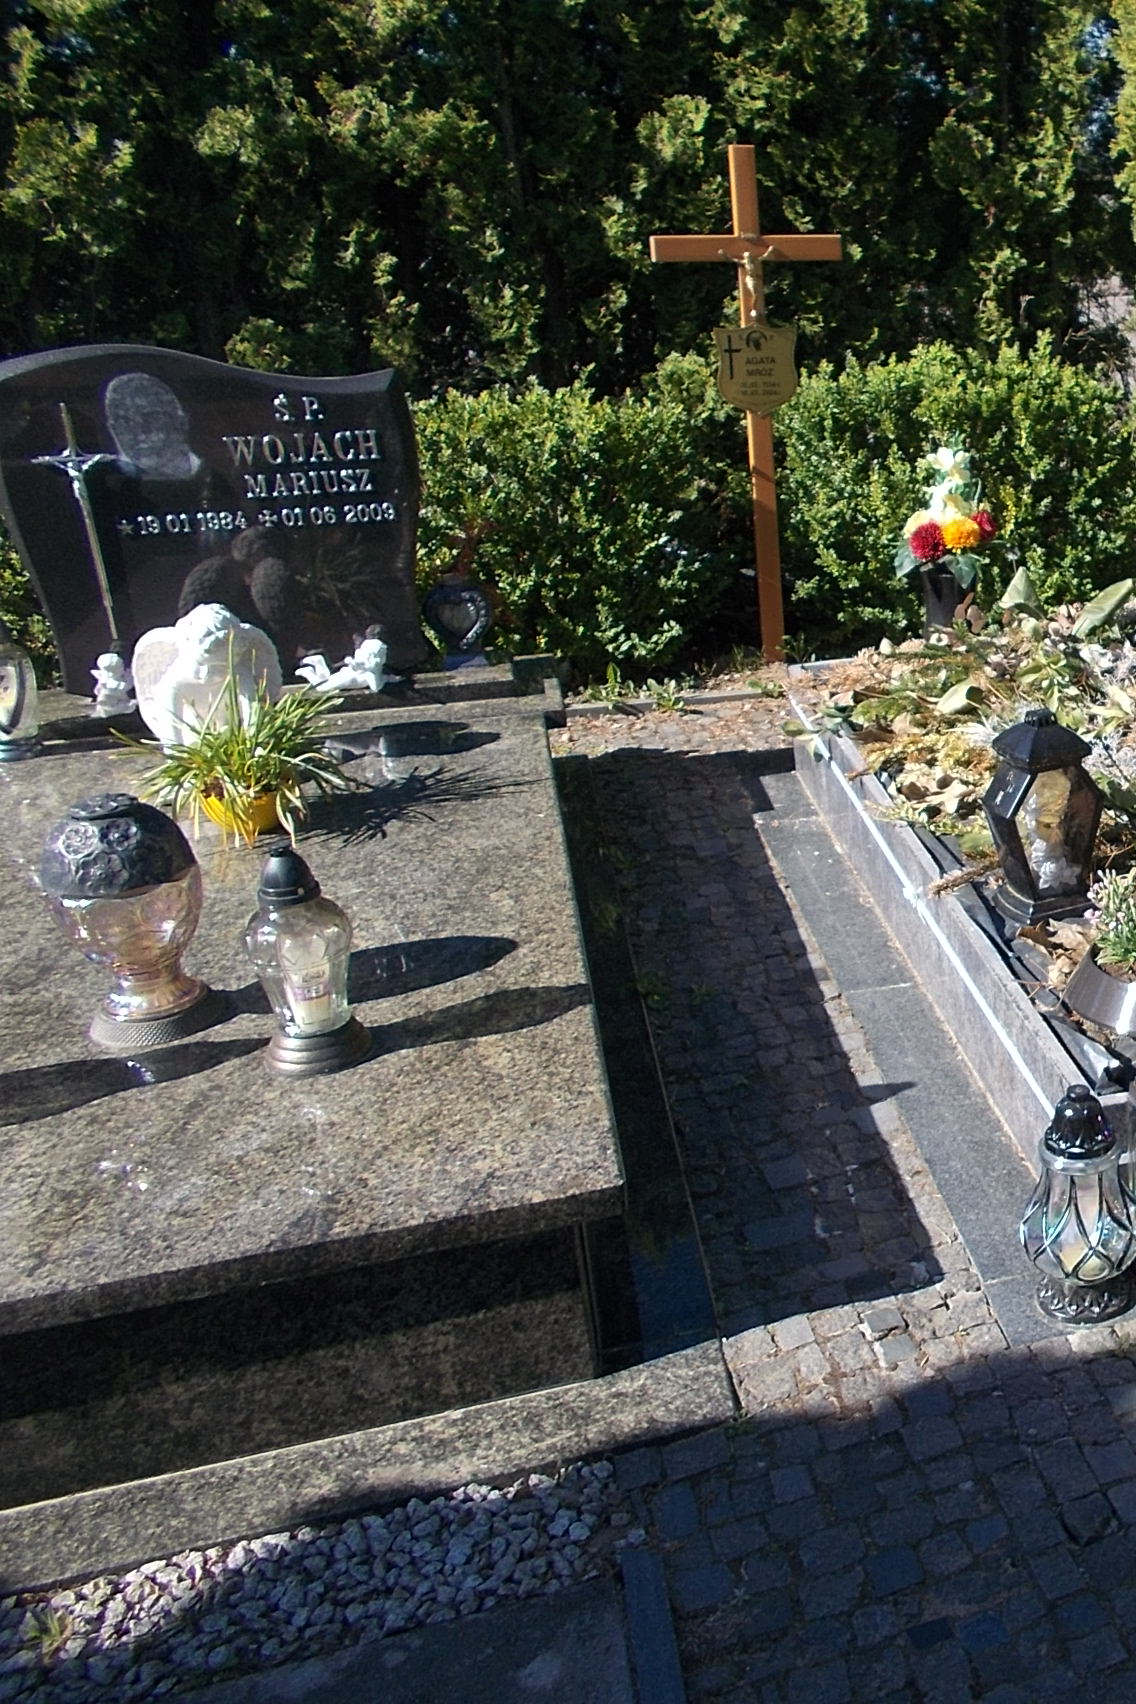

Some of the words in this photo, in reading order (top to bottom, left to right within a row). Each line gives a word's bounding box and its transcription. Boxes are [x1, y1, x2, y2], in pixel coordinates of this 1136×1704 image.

[302, 396, 324, 421] P.
[222, 429, 381, 466] WOJACH
[244, 469, 373, 498] MARIUSZ
[137, 515, 161, 535] 19
[166, 513, 192, 532] 01
[197, 510, 247, 531] 1984
[281, 507, 304, 526] 01
[310, 506, 336, 525] 06
[344, 502, 395, 523] 2009
